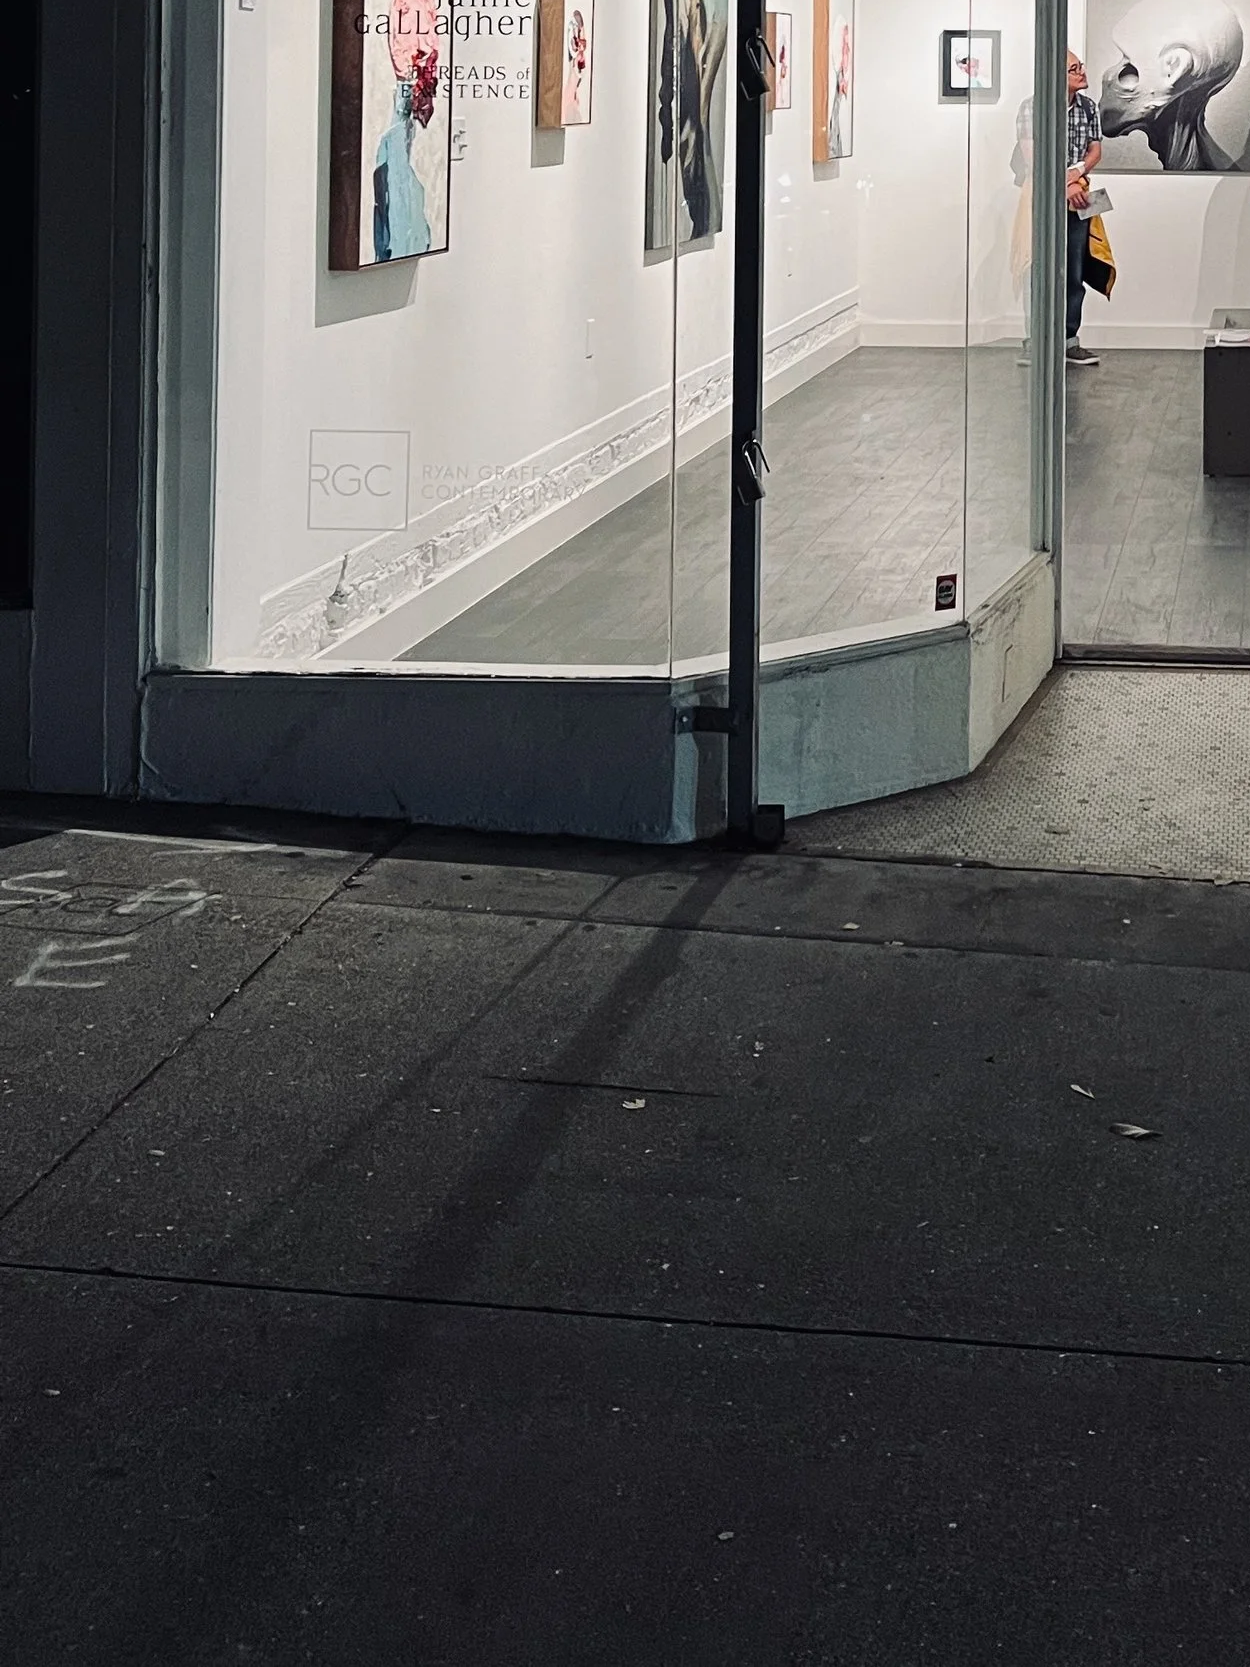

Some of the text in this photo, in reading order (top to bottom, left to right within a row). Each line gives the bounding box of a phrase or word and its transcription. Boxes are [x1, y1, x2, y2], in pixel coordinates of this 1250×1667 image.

[516, 67, 531, 80] of
[310, 464, 392, 497] RGC
[422, 465, 542, 481] RYAN GRAFF
